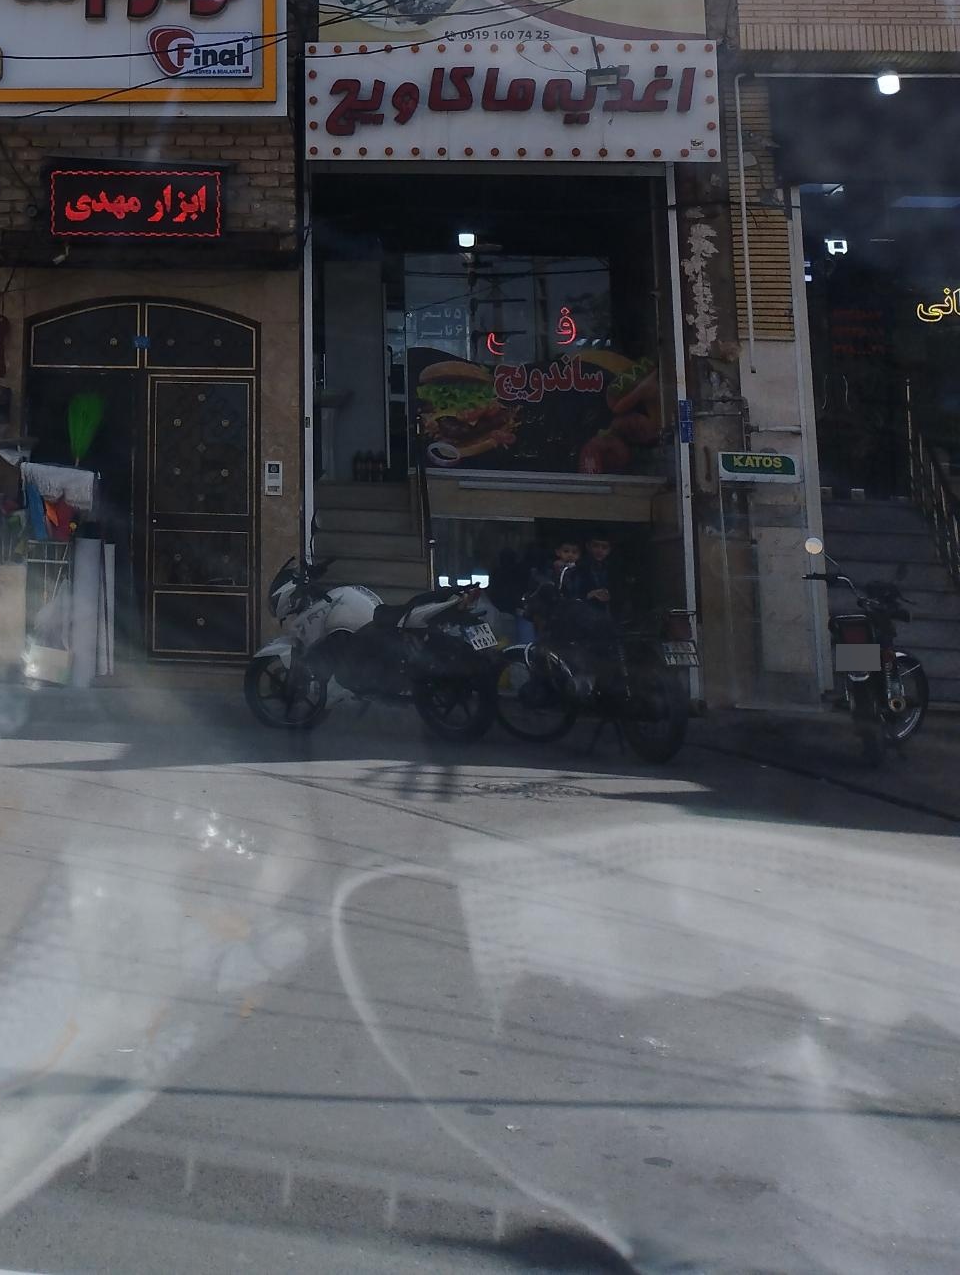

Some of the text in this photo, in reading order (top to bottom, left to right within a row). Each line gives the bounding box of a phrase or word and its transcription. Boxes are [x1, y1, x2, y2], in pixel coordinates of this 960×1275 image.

[460, 30, 550, 41] 0919 160 74 25
[177, 42, 244, 66] Final
[64, 182, 208, 223] ابزار مهدی
[494, 354, 604, 403] ساندویچ
[732, 455, 783, 469] KATOS
